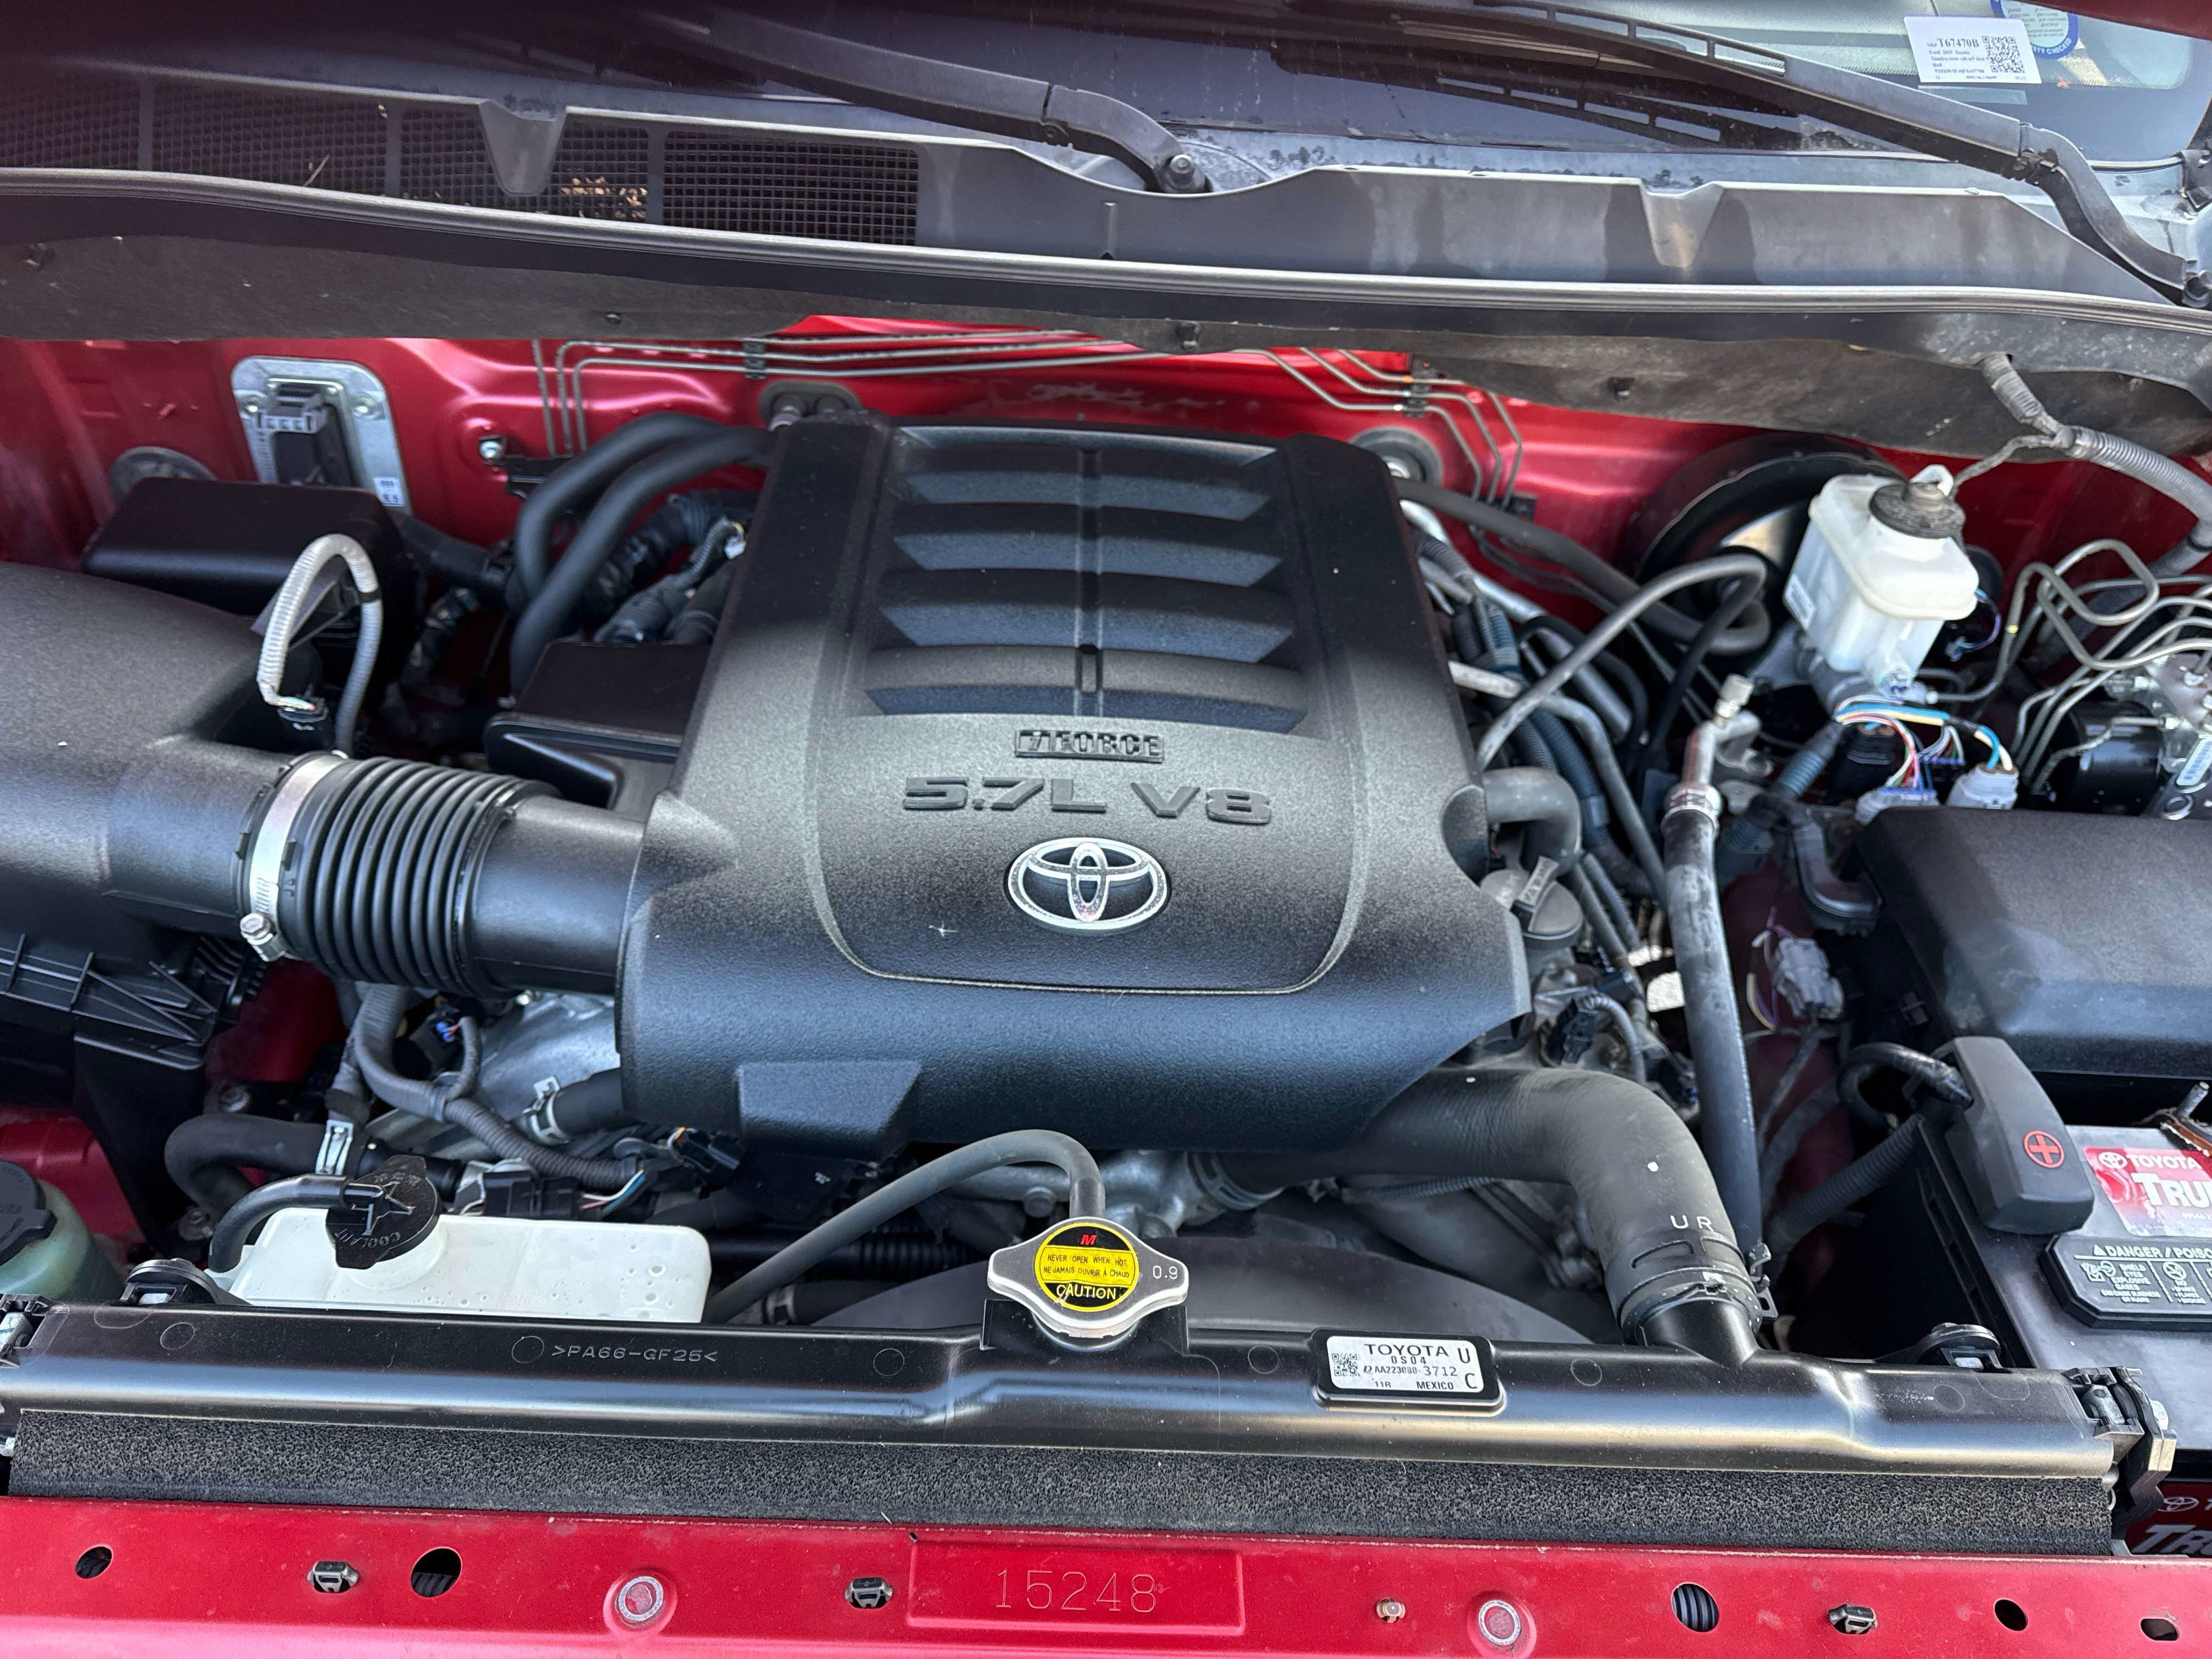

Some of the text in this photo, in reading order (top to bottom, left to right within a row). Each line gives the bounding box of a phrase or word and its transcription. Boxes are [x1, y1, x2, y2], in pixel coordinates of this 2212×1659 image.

[1937, 37, 1979, 47] T67470B
[2046, 37, 2072, 54] CHECKED
[903, 777, 1272, 825] 5.7L V8
[2126, 1154, 2203, 1170] TOYOTA
[1072, 1255, 1088, 1263] OPEN
[1093, 1256, 1110, 1264] WHEN
[2104, 1245, 2163, 1258] DANGER
[1078, 1268, 1100, 1277] OUVRIR
[1110, 1269, 1130, 1278] CHAUD
[1153, 1266, 1177, 1280] 0.9
[1056, 1284, 1116, 1300] CAUTION
[1364, 1344, 1471, 1363] TOYOTA U
[1416, 1381, 1453, 1390] MEXICO
[1464, 1373, 1478, 1389] C
[996, 1569, 1156, 1613] 15248
